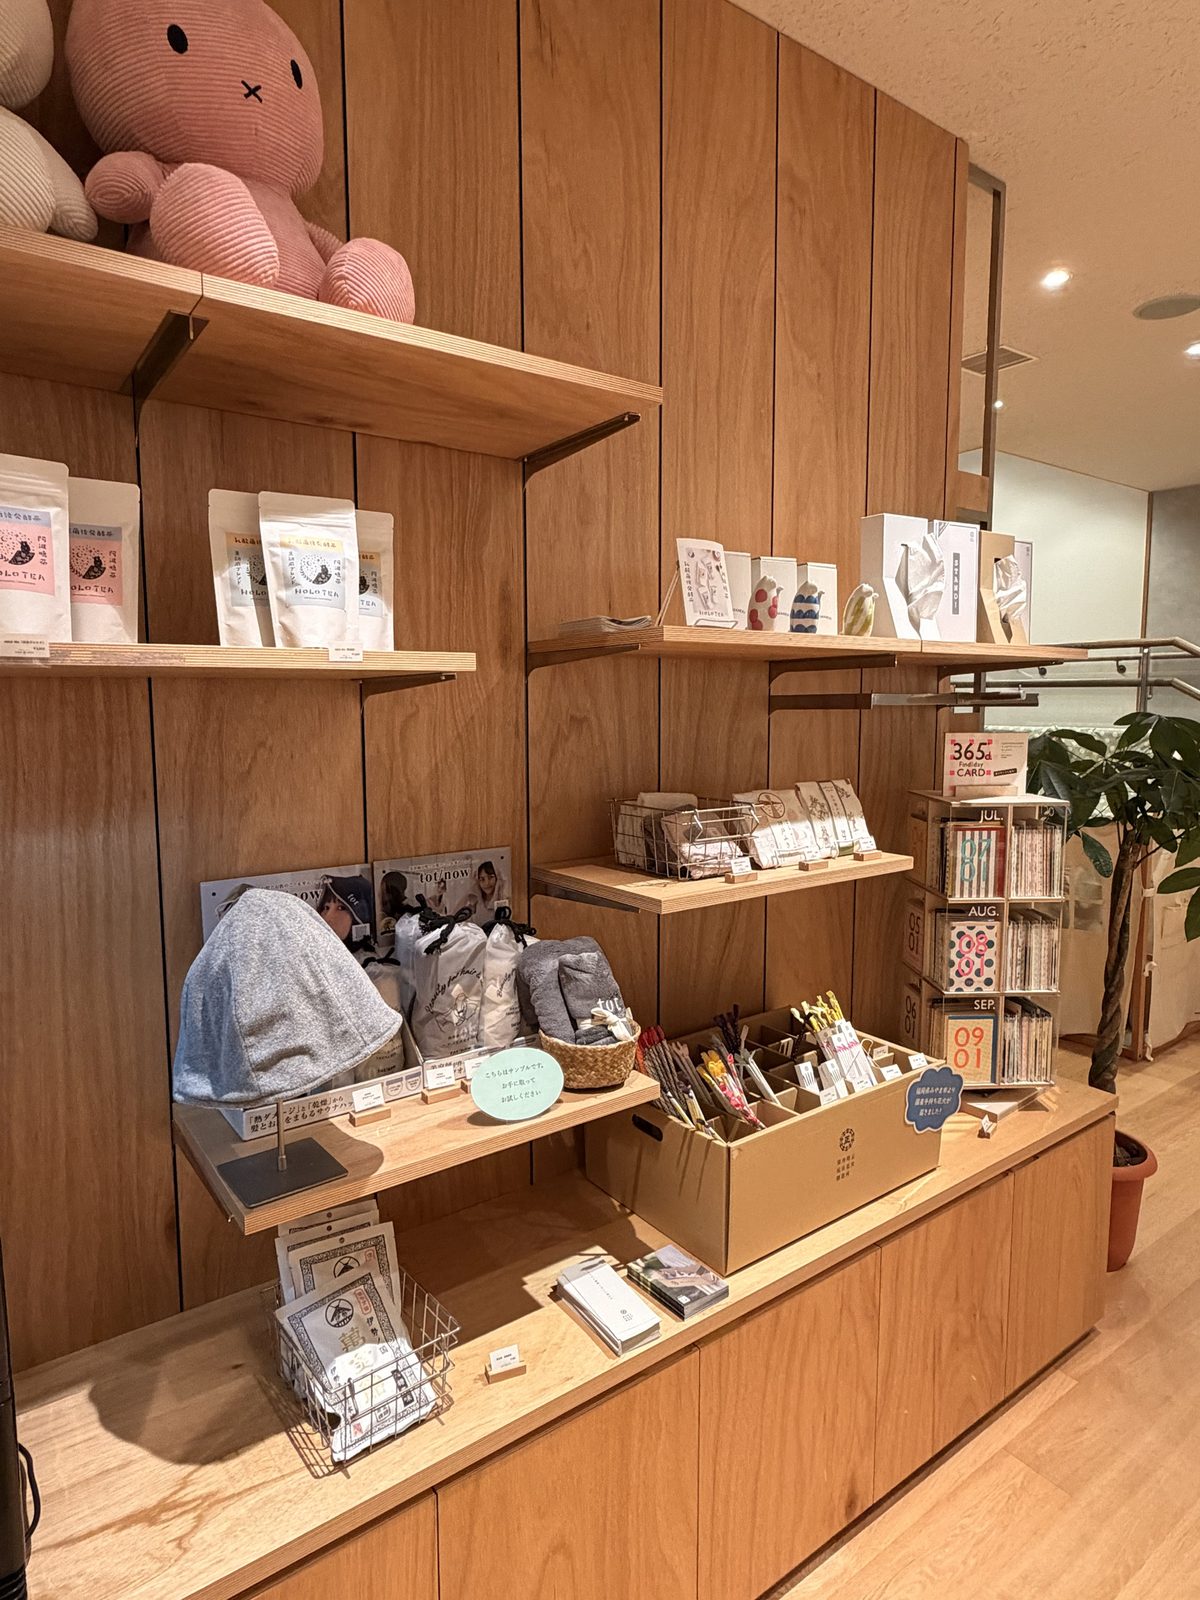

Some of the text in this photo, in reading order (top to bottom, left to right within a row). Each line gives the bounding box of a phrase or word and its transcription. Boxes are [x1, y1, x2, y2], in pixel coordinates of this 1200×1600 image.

[295, 588, 340, 598] HOLO TEA
[956, 768, 986, 777] CARD
[979, 810, 1004, 824] JUL.
[968, 906, 1000, 917] AUG.
[958, 933, 989, 954] 08
[957, 955, 985, 977] 01
[973, 999, 997, 1011] SEP.
[954, 1026, 985, 1048] 09
[953, 1048, 982, 1069] 01
[485, 1062, 545, 1080] こちらはサンプルです。
[502, 1076, 537, 1089] お手に取って
[501, 1090, 542, 1103] お試しください
